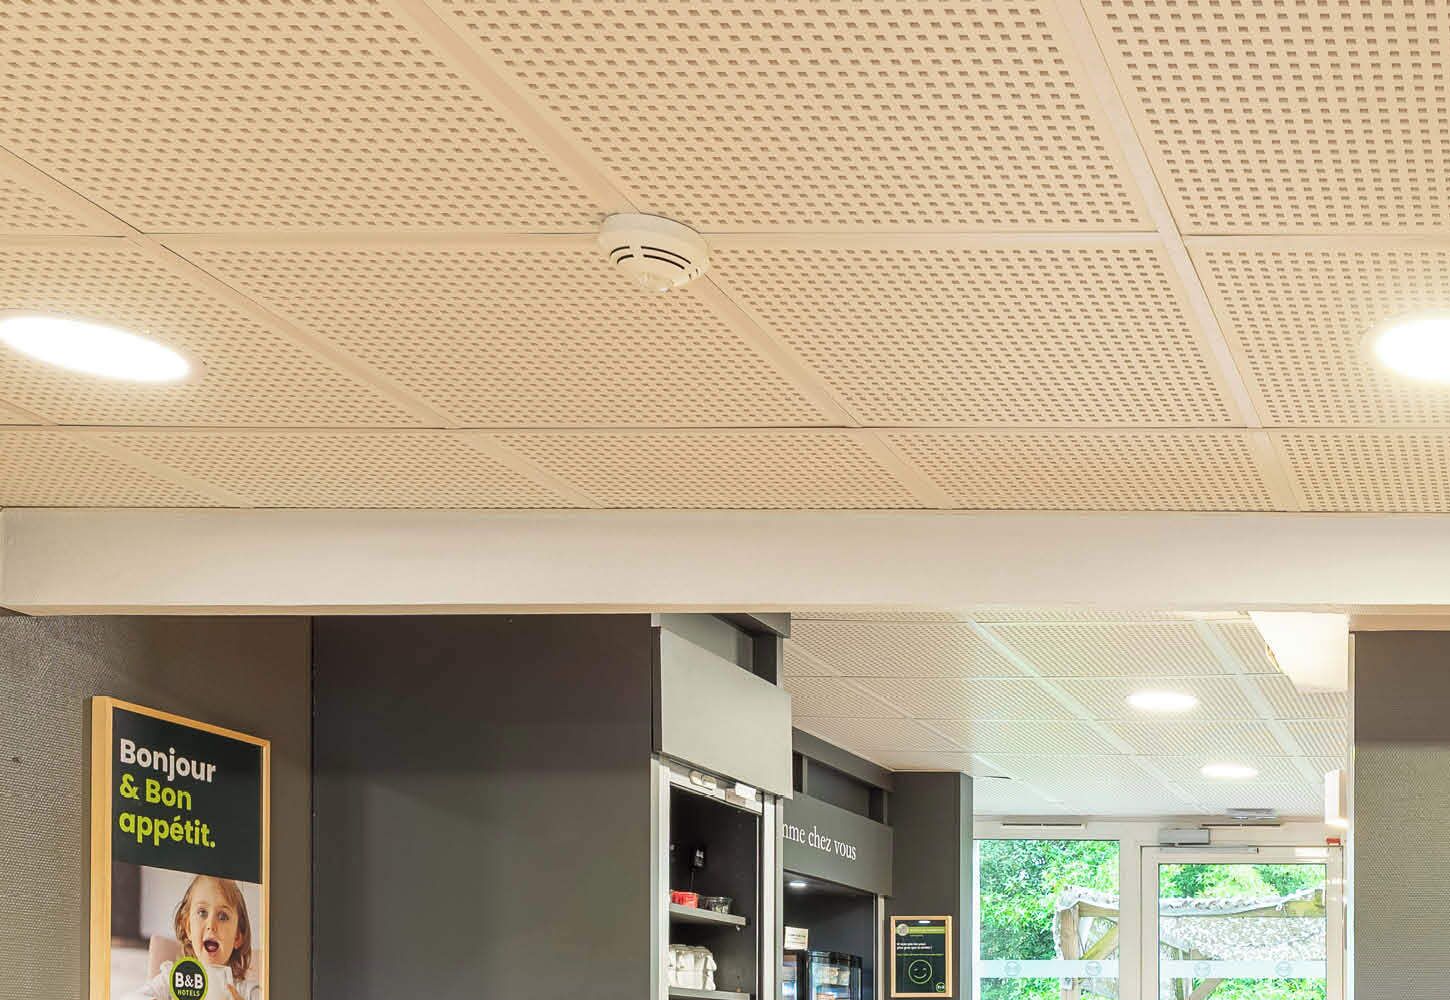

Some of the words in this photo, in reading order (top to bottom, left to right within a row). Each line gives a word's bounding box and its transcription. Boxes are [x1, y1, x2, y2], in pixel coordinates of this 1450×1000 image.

[119, 738, 216, 783] Bonjour
[119, 773, 140, 800] &
[145, 778, 192, 811] Bon
[119, 811, 216, 848] appétit.
[808, 825, 832, 852] chez
[833, 840, 857, 861] vous
[175, 971, 204, 989] B&B
[177, 988, 201, 998] HOTELS
